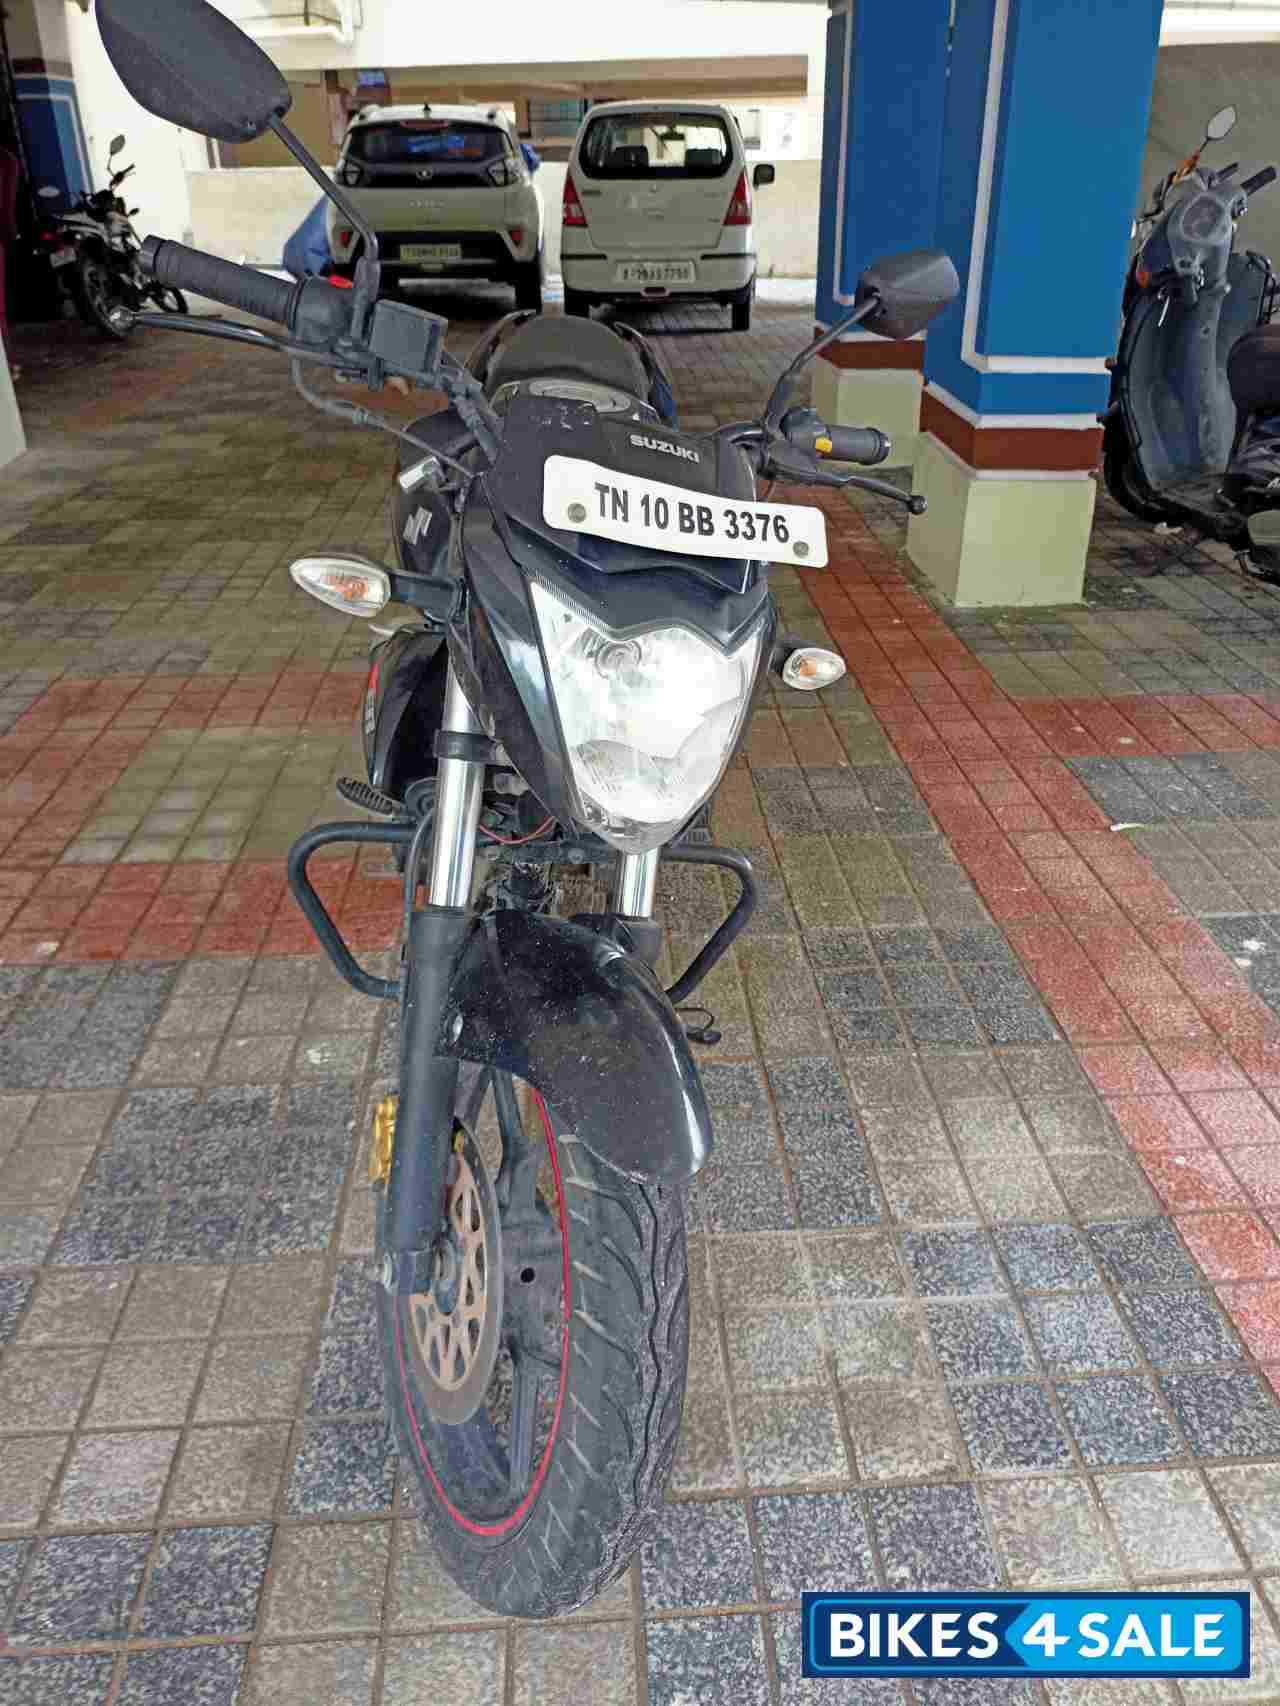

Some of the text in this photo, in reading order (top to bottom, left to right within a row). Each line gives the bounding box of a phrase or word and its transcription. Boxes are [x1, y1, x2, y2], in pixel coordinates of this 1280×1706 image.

[630, 434, 700, 464] SUZUKI
[595, 482, 790, 543] TN 10 BB 3376
